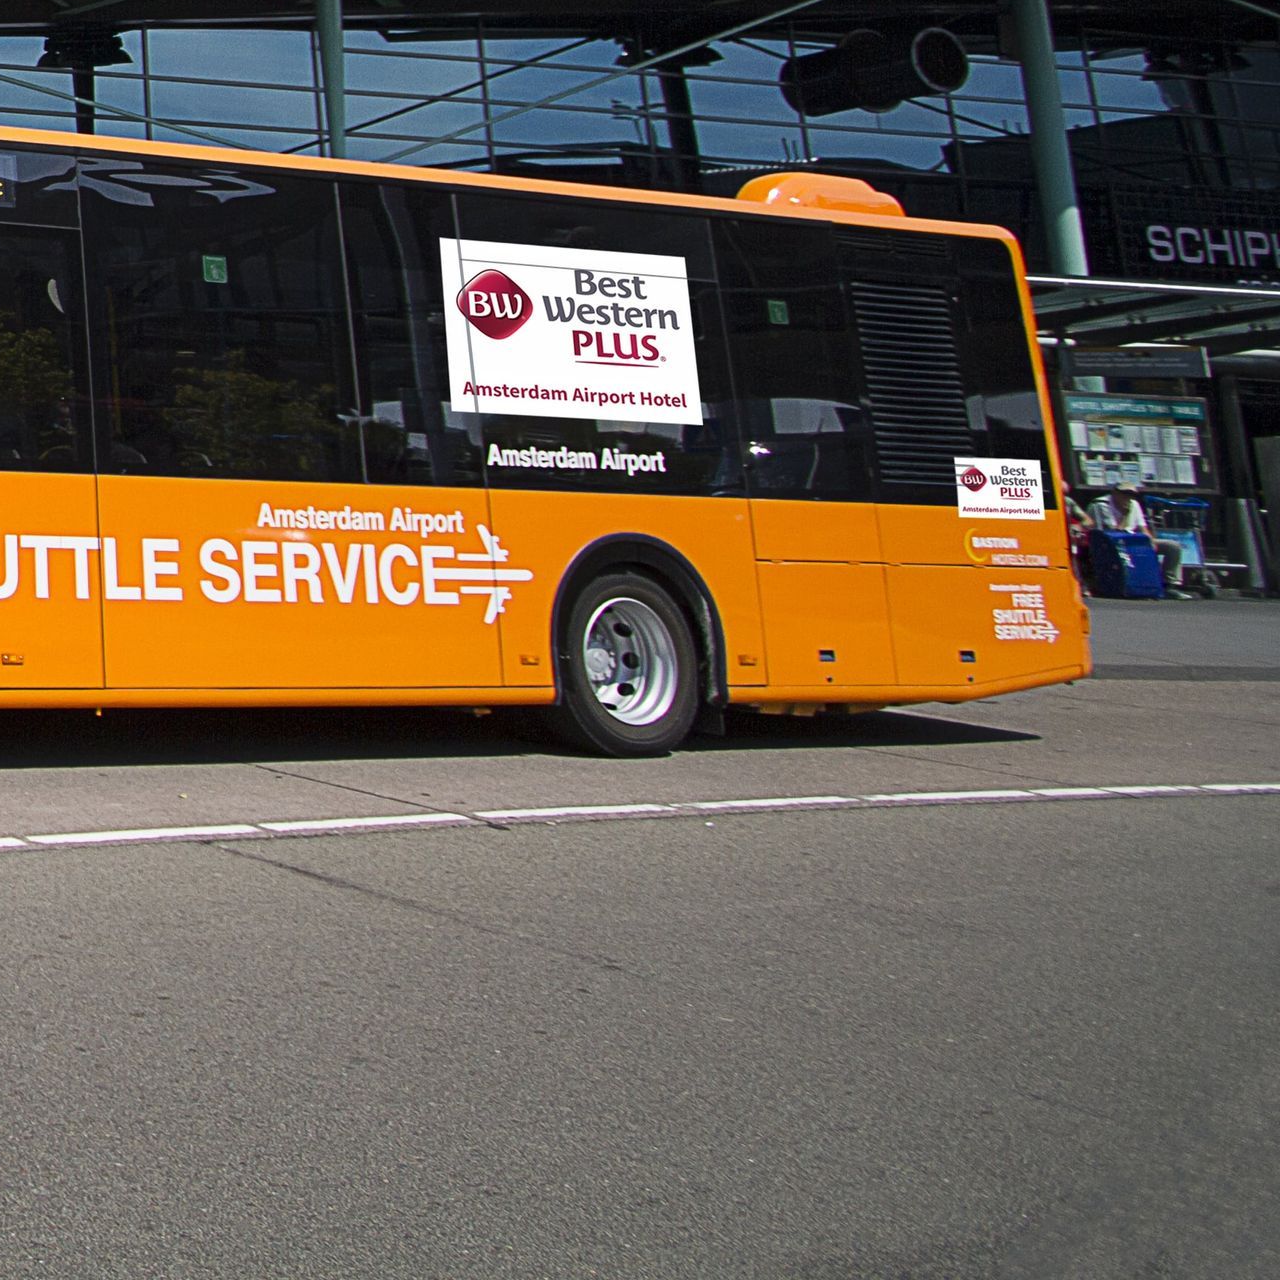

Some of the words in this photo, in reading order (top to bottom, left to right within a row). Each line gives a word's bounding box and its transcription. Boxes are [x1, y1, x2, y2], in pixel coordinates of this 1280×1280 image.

[1146, 225, 1280, 269] SCHIP
[573, 269, 647, 300] Best
[467, 289, 524, 321] BW
[542, 294, 680, 330] Western
[462, 380, 569, 404] Amsterdam
[572, 385, 636, 408] Airport
[640, 390, 688, 410] Hotel
[487, 443, 598, 471] Amsterdam
[600, 447, 666, 475] Airport
[1001, 466, 1027, 476] Best
[963, 474, 985, 485] BW
[990, 476, 1038, 487] Western
[256, 502, 384, 532] Amsterdam
[388, 506, 464, 537] Airport
[962, 506, 999, 514] Amsterdam
[999, 507, 1022, 515] Airport
[199, 537, 460, 606] SERVICE
[1013, 594, 1044, 608] FREE
[993, 609, 1046, 624] SHUTTLE
[994, 625, 1044, 641] SERVICE
